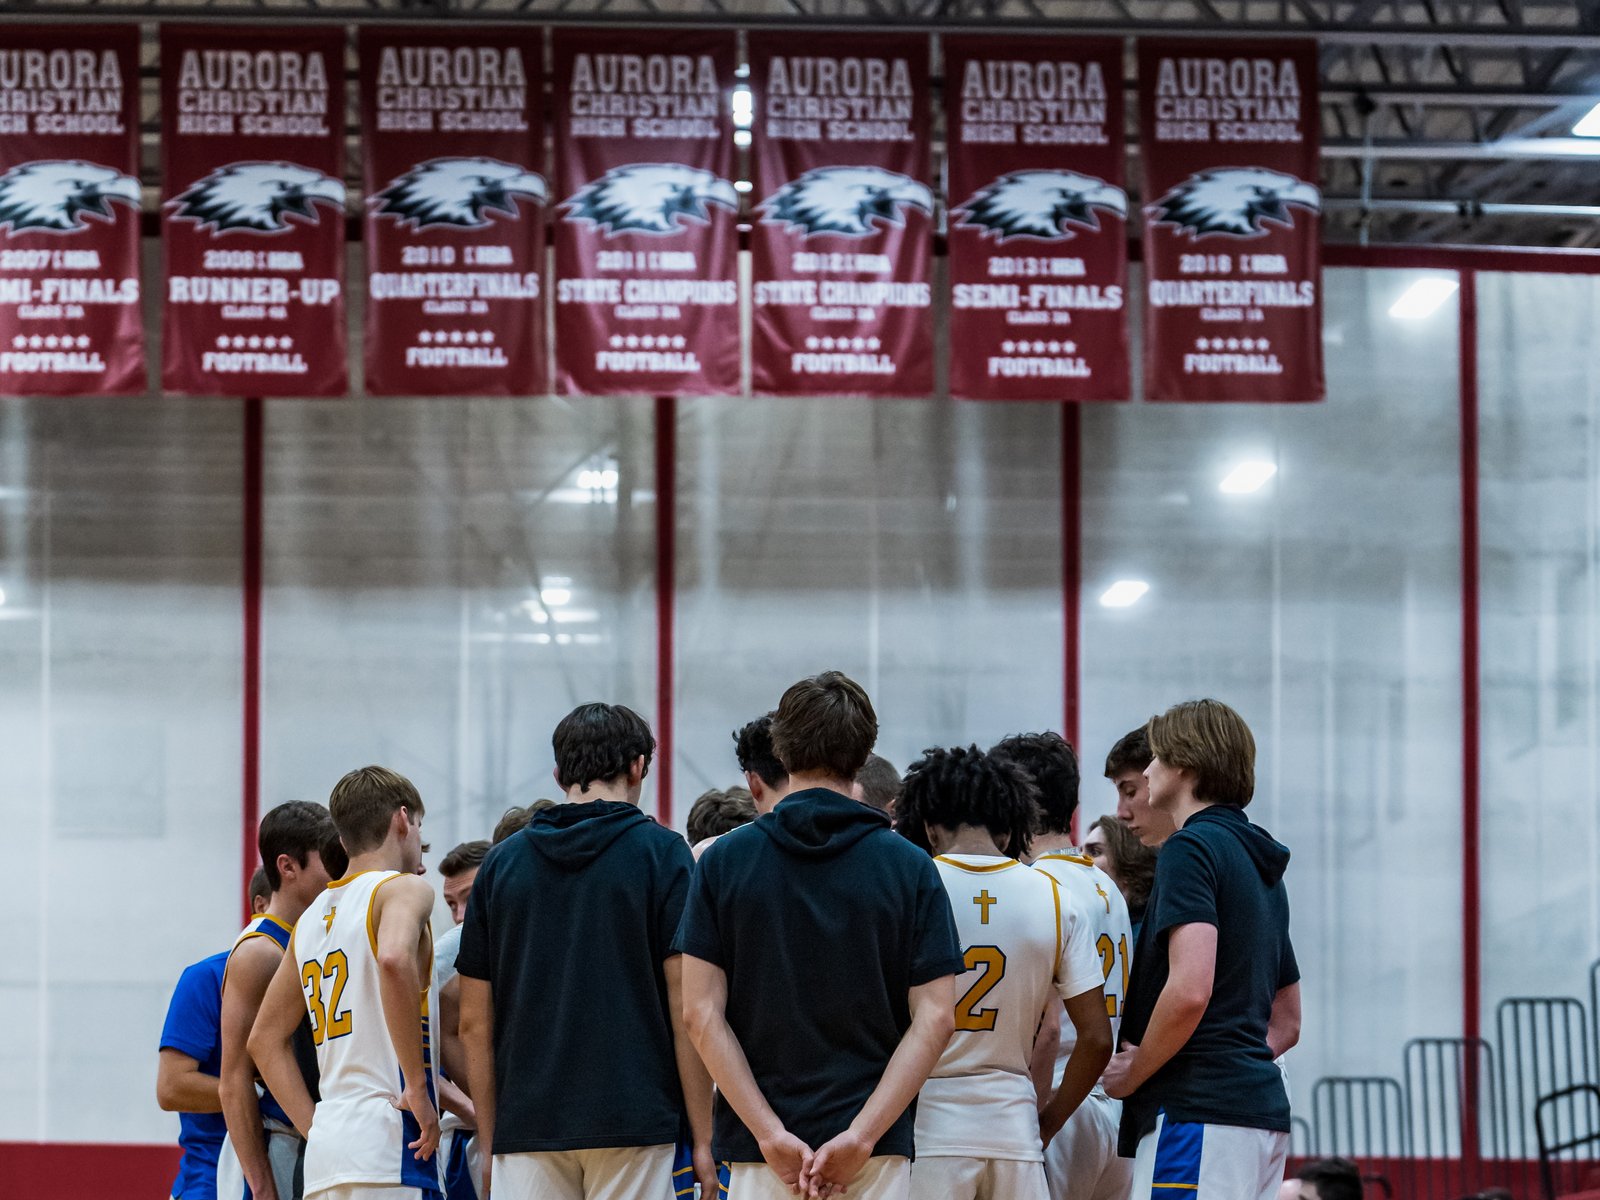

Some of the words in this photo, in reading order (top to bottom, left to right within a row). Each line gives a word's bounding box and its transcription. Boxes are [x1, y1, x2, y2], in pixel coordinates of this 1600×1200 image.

[179, 51, 327, 90] AURORA
[378, 47, 526, 86] AURORA
[571, 54, 720, 92] AURORA
[767, 57, 912, 96] AURORA
[962, 61, 1106, 99] AURORA
[1157, 59, 1300, 98] AURORA
[179, 90, 326, 114] CHRISTIAN
[378, 86, 525, 110] CHRISTIAN
[573, 93, 719, 117] CHRISTIAN
[767, 97, 911, 119] CHRISTIAN
[378, 110, 433, 130] HIGH
[441, 111, 528, 131] SCHOOL
[963, 101, 1105, 123] CHRISTIAN
[1157, 98, 1299, 121] CHRISTIAN
[35, 114, 124, 134] SCHOOL
[179, 115, 233, 134] HIGH
[241, 115, 329, 136] SCHOOL
[571, 118, 626, 137] HIGH
[633, 118, 719, 138] SCHOOL
[767, 120, 821, 140] HIGH
[828, 120, 914, 141] SCHOOL
[962, 124, 1015, 143] HIGH
[1023, 124, 1108, 144] SCHOOL
[1157, 122, 1209, 140] HIGH
[1217, 122, 1302, 142] SCHOOL
[402, 246, 455, 265] 2010
[596, 251, 646, 270] 2011
[792, 252, 843, 272] 2012
[989, 257, 1038, 276] 2013
[169, 277, 340, 306] RUNNER-UP
[370, 273, 539, 299] QUARTERFINALS
[558, 278, 621, 304] STATE
[624, 279, 736, 305] CHAMPIONS
[754, 281, 817, 305] STATE
[820, 281, 930, 306] CHAMPIONS
[953, 284, 1122, 309] SEMI-FINALS
[1149, 280, 1314, 306] QUARTERFINALS
[0, 352, 105, 372] FOOTBALL
[203, 352, 307, 373] FOOTBALL
[407, 347, 508, 366] FOOTBALL
[596, 351, 701, 373] FOOTBALL
[792, 353, 896, 374] FOOTBALL
[989, 357, 1091, 377] FOOTBALL
[1185, 354, 1282, 374] FOOTBALL
[1096, 933, 1130, 1017] 21
[302, 948, 353, 1047] 32
[954, 945, 1007, 1031] 2
